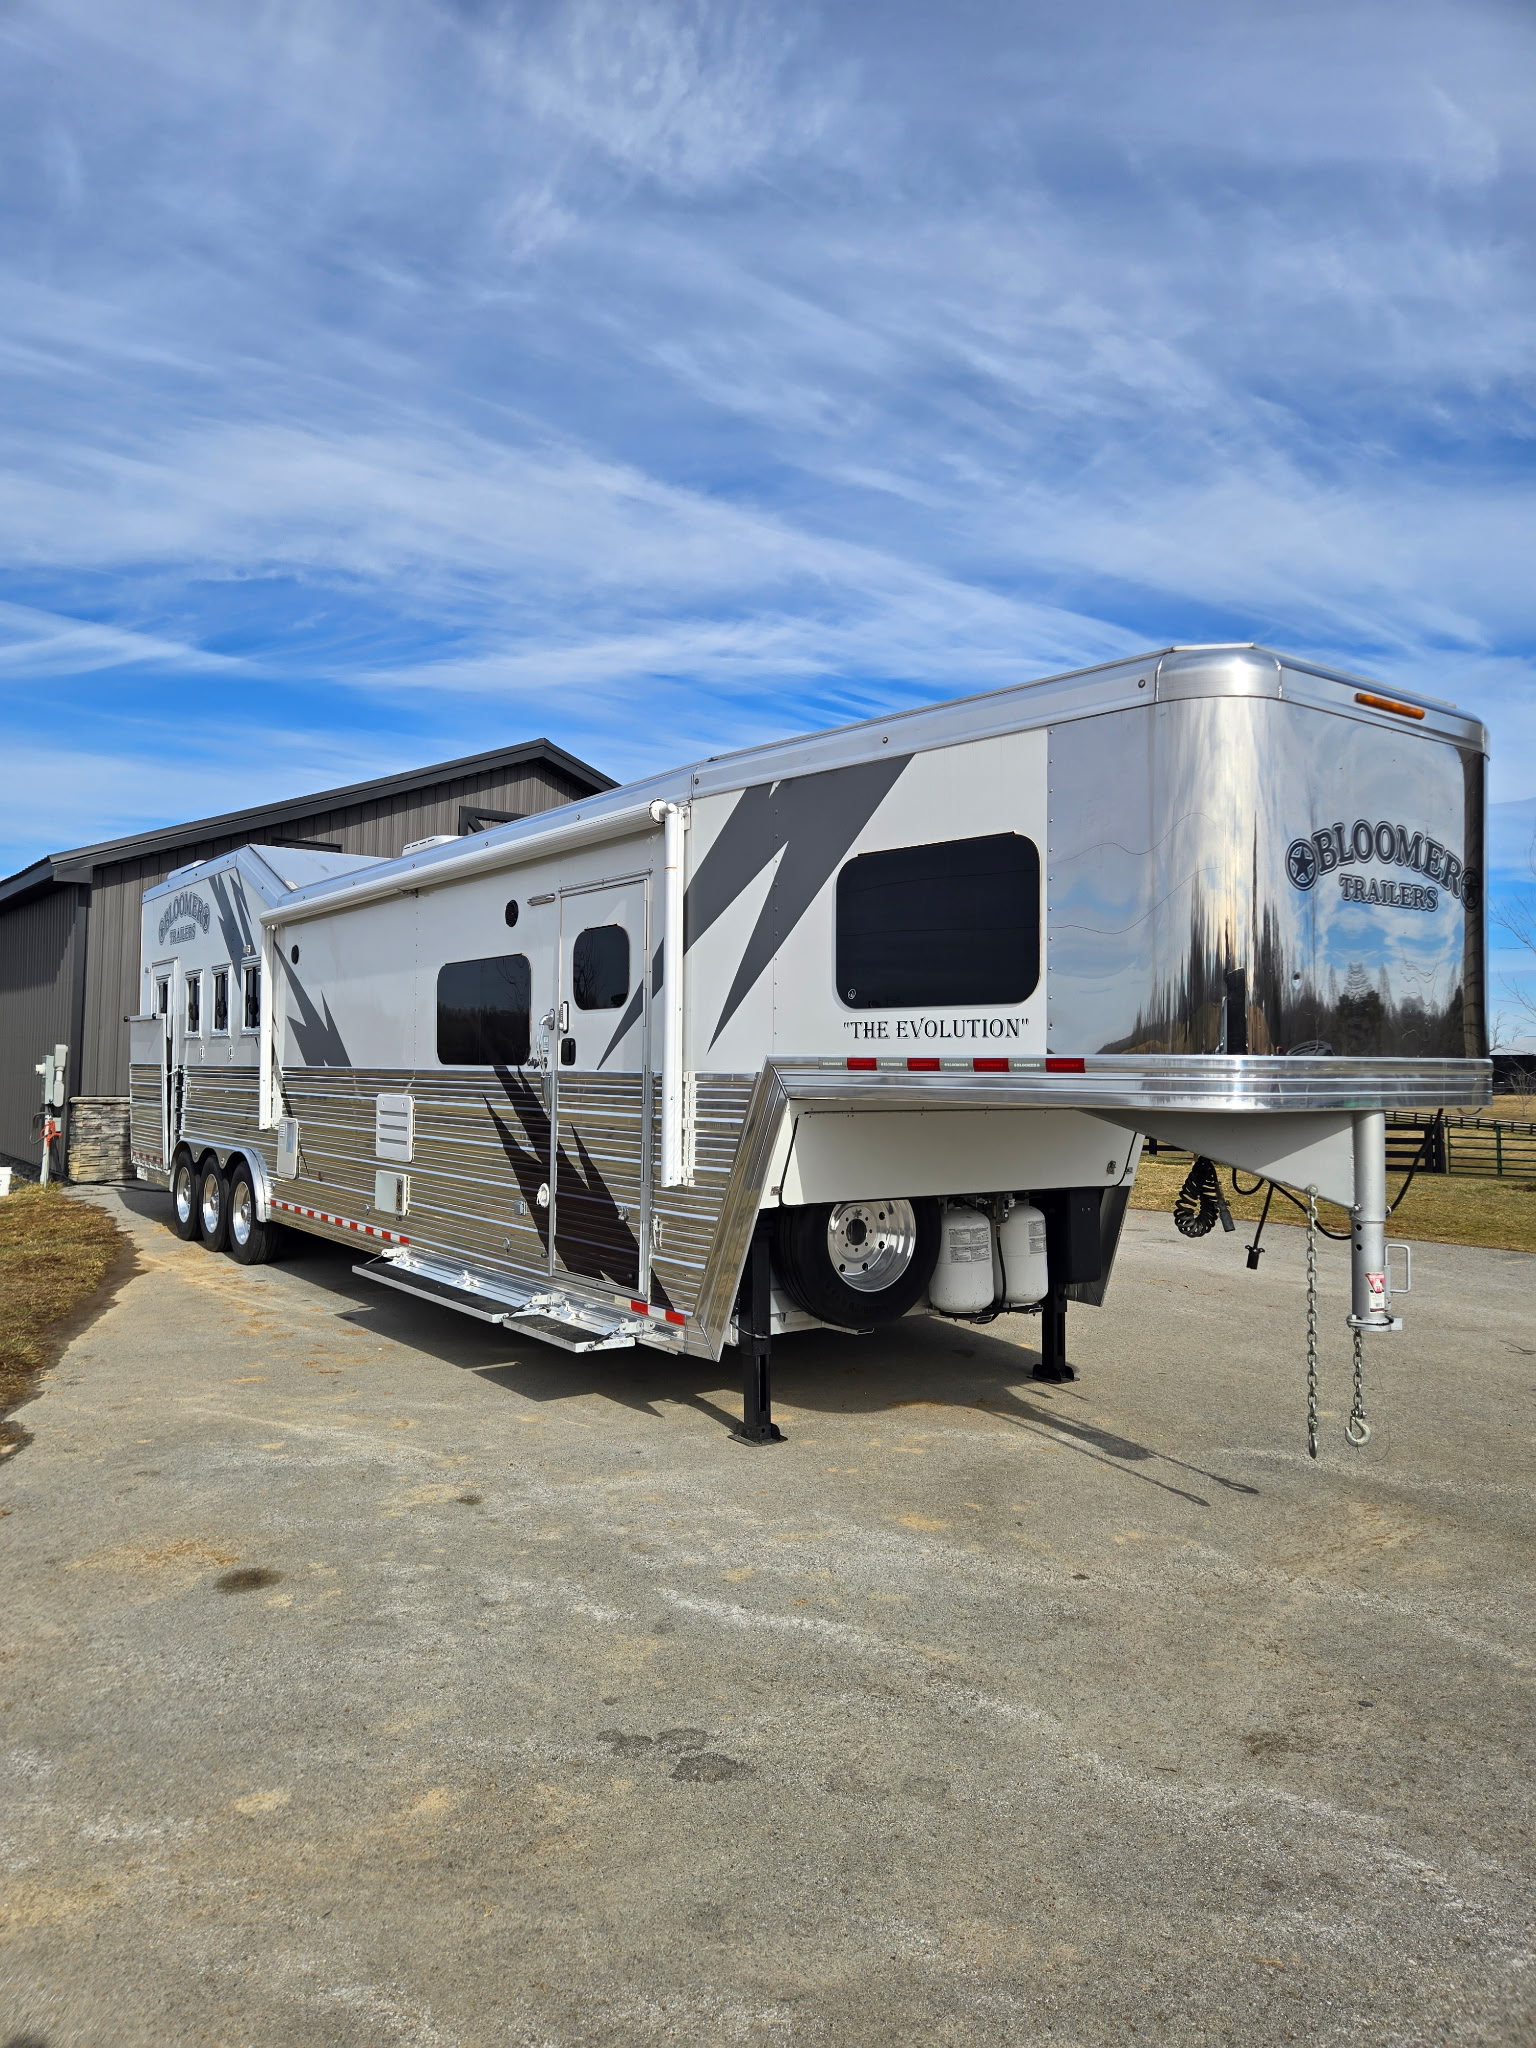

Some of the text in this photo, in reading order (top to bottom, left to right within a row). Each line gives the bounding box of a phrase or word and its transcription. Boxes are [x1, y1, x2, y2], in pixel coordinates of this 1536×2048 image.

[1312, 819, 1463, 899] BLOOMER
[1339, 873, 1438, 912] TRAILERS
[169, 922, 196, 946] TRAILERS
[843, 1016, 1030, 1040] "THE EVOLUTION"
